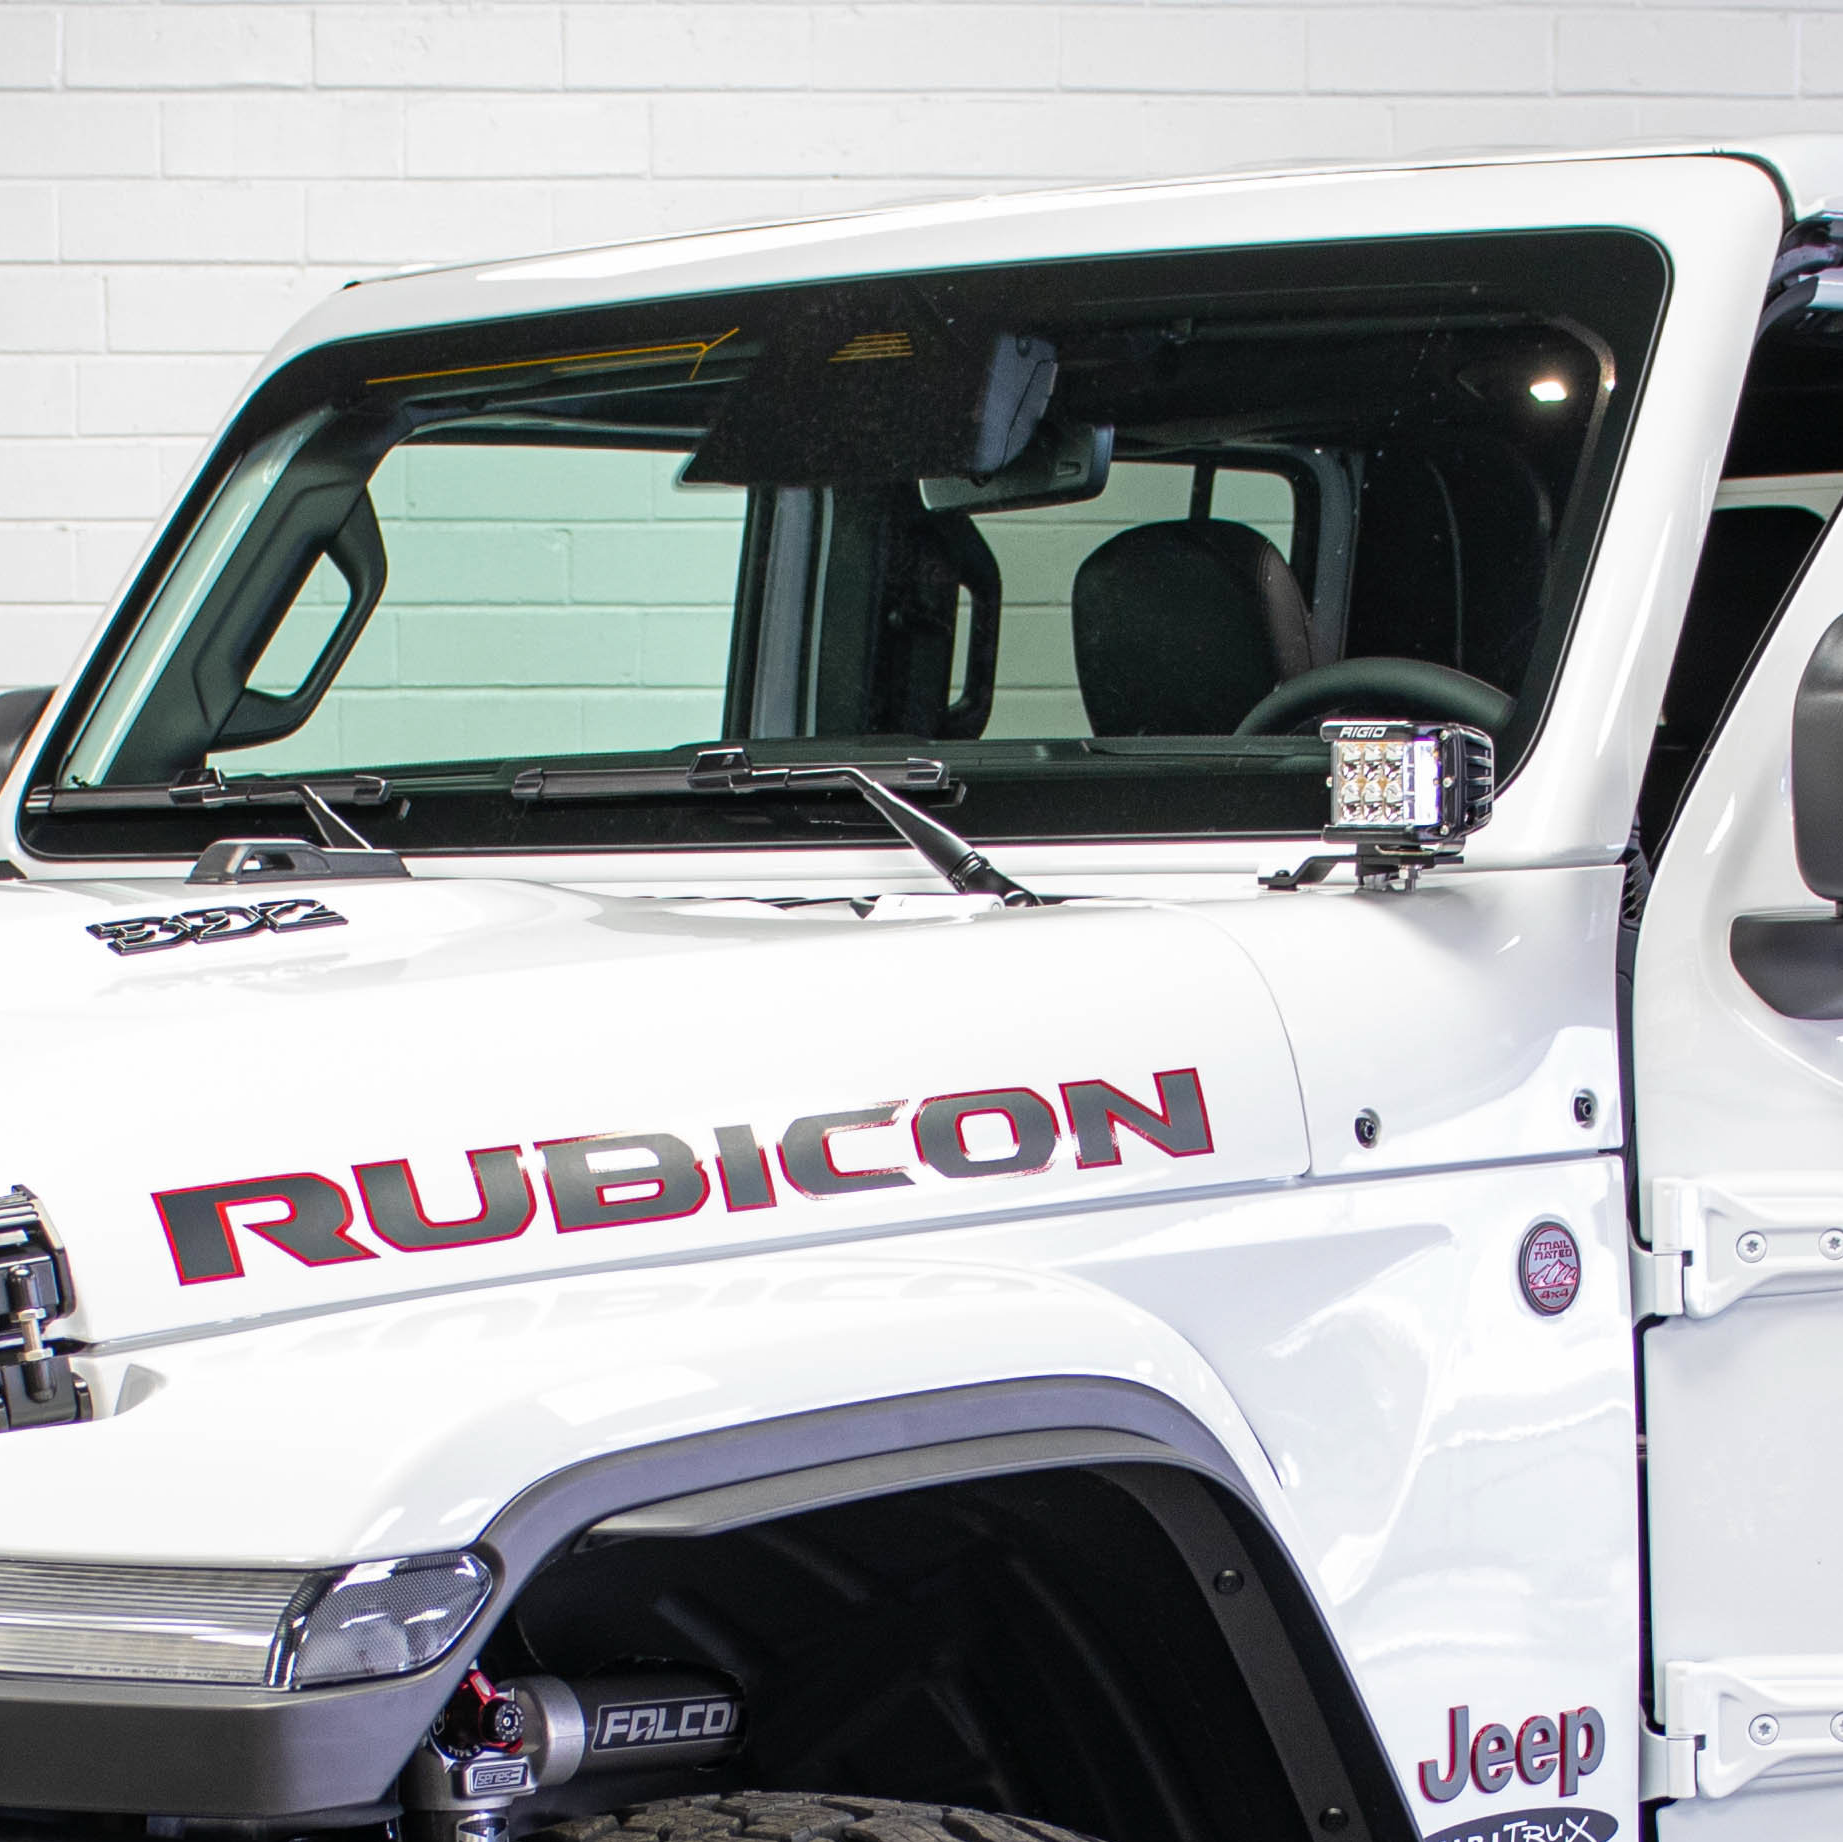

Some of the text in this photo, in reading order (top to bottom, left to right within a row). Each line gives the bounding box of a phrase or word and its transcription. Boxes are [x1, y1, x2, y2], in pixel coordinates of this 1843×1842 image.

[1339, 726, 1388, 738] RIGID
[151, 1068, 1215, 1285] RUBICON
[1533, 1248, 1573, 1261] RATED
[1535, 1240, 1570, 1251] TRAIL
[601, 1702, 739, 1745] FALCO
[1418, 1705, 1606, 1803] Jeep
